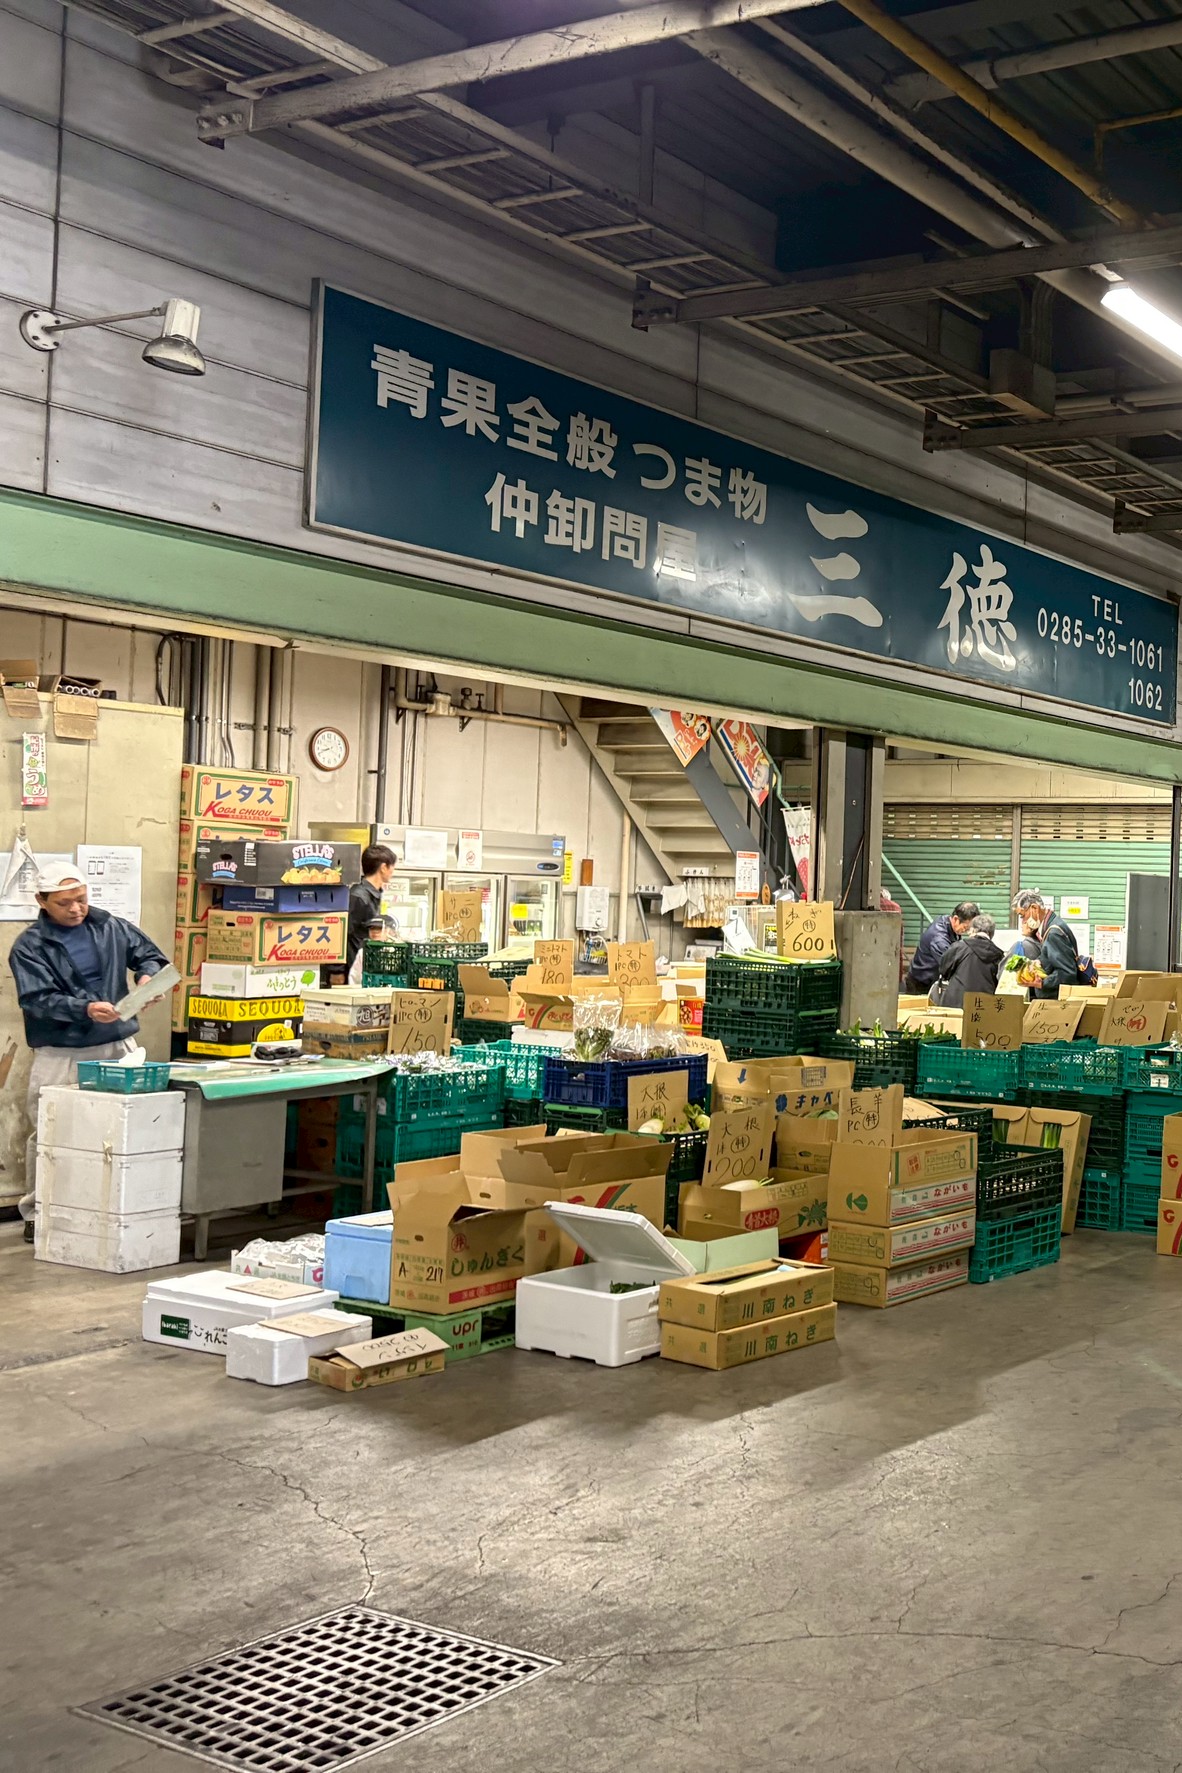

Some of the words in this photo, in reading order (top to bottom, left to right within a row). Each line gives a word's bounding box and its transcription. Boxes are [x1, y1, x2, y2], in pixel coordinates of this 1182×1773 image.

[371, 344, 617, 479] 青果全般
[633, 443, 768, 525] つま物
[484, 472, 697, 582] 仲卸問屋
[787, 502, 1018, 672] 三徳
[1092, 595, 1123, 625] TEL
[1037, 608, 1163, 673] 0285-33-1061
[1129, 679, 1163, 711] 1062
[216, 783, 274, 805] レタス
[239, 808, 272, 816] CHUOU
[278, 925, 331, 944] レタス
[793, 932, 824, 951] 600
[617, 949, 647, 960] トマト
[1029, 1021, 1059, 1035] 150
[401, 1026, 437, 1054] 150
[795, 1091, 840, 1108] キャベ
[934, 1183, 968, 1197] ながいも
[934, 1221, 968, 1236] ながいも
[928, 1258, 961, 1274] ながいも
[743, 1288, 815, 1319] 川南ねぎ
[453, 1319, 479, 1336] upr
[745, 1324, 816, 1357] 川南ねぎ
